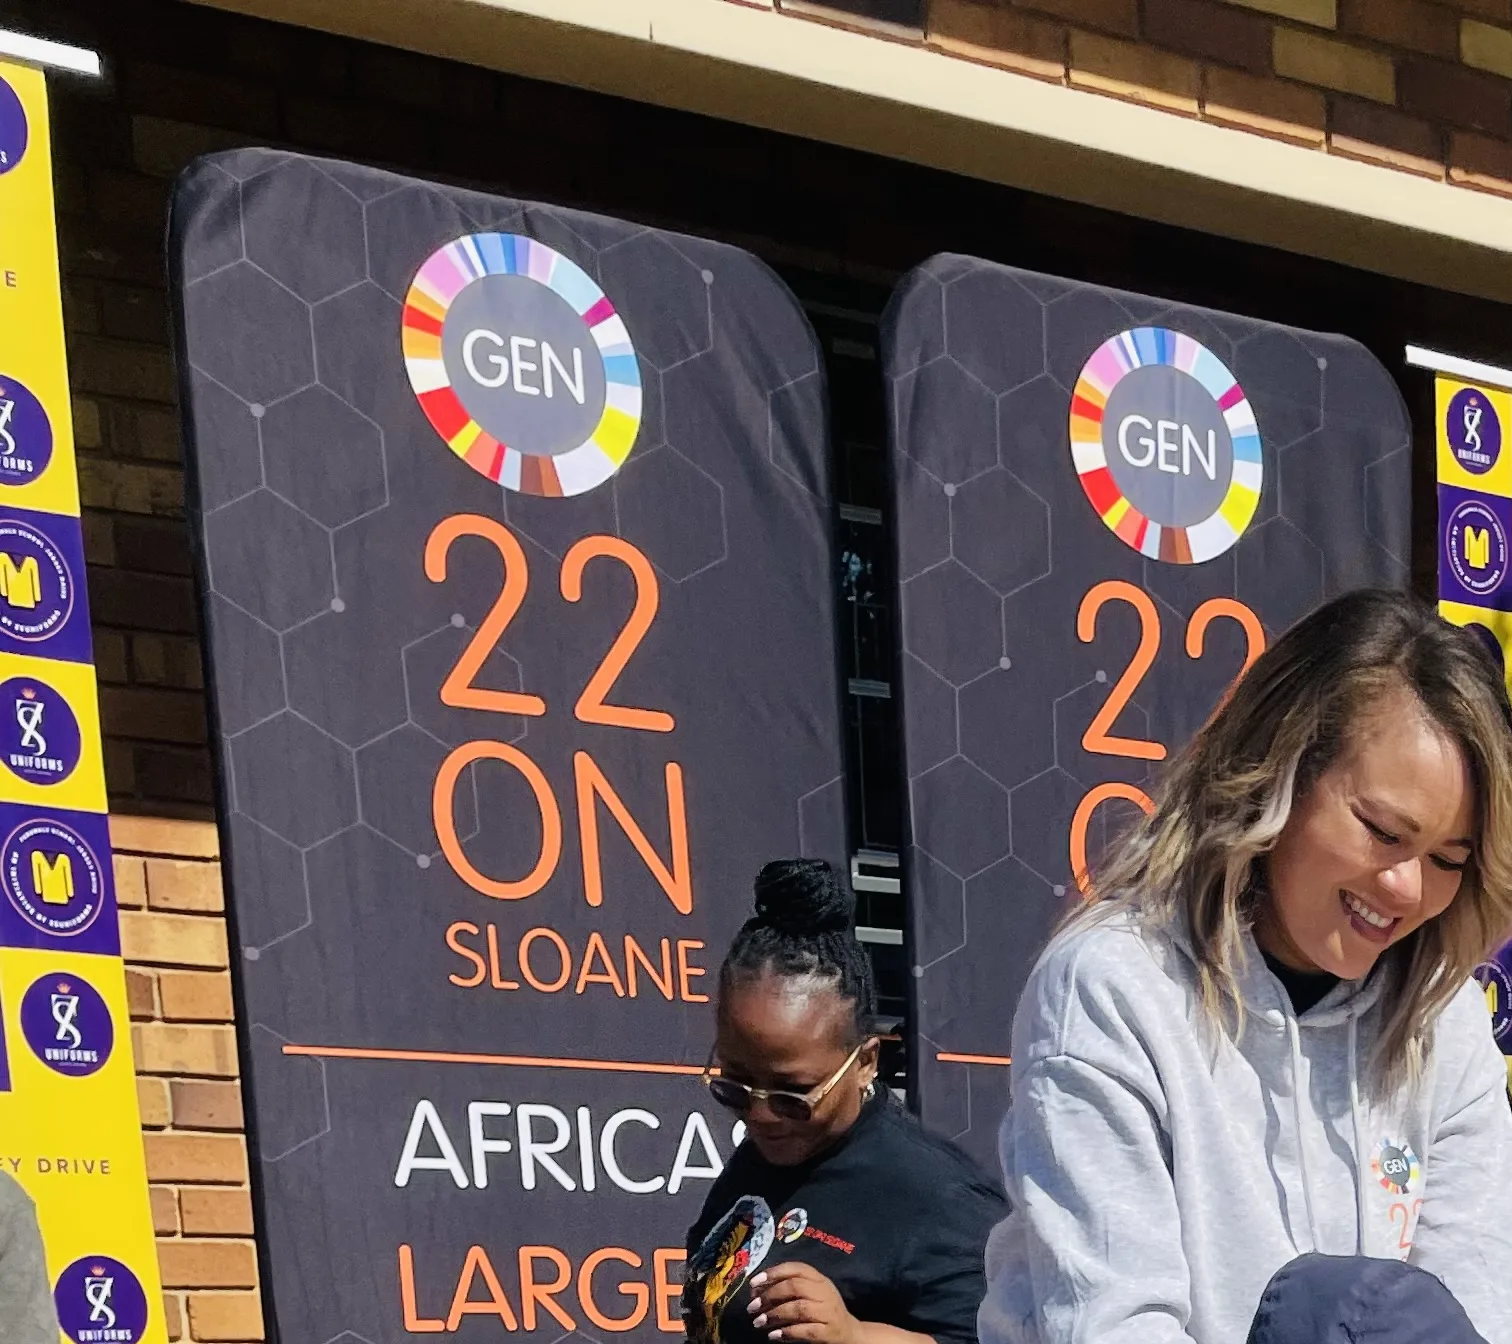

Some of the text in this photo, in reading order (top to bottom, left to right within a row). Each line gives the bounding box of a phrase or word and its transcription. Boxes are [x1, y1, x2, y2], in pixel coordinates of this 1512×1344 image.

[461, 327, 587, 406] GEN
[1117, 413, 1217, 481] GEN
[423, 513, 676, 732] 22
[433, 738, 693, 915] ON
[445, 919, 710, 1004] SLOANE
[37, 1158, 111, 1175] DRIVE
[394, 1099, 747, 1196] AFRICA
[1383, 1157, 1409, 1175] GEN
[398, 1243, 688, 1333] LARGE
